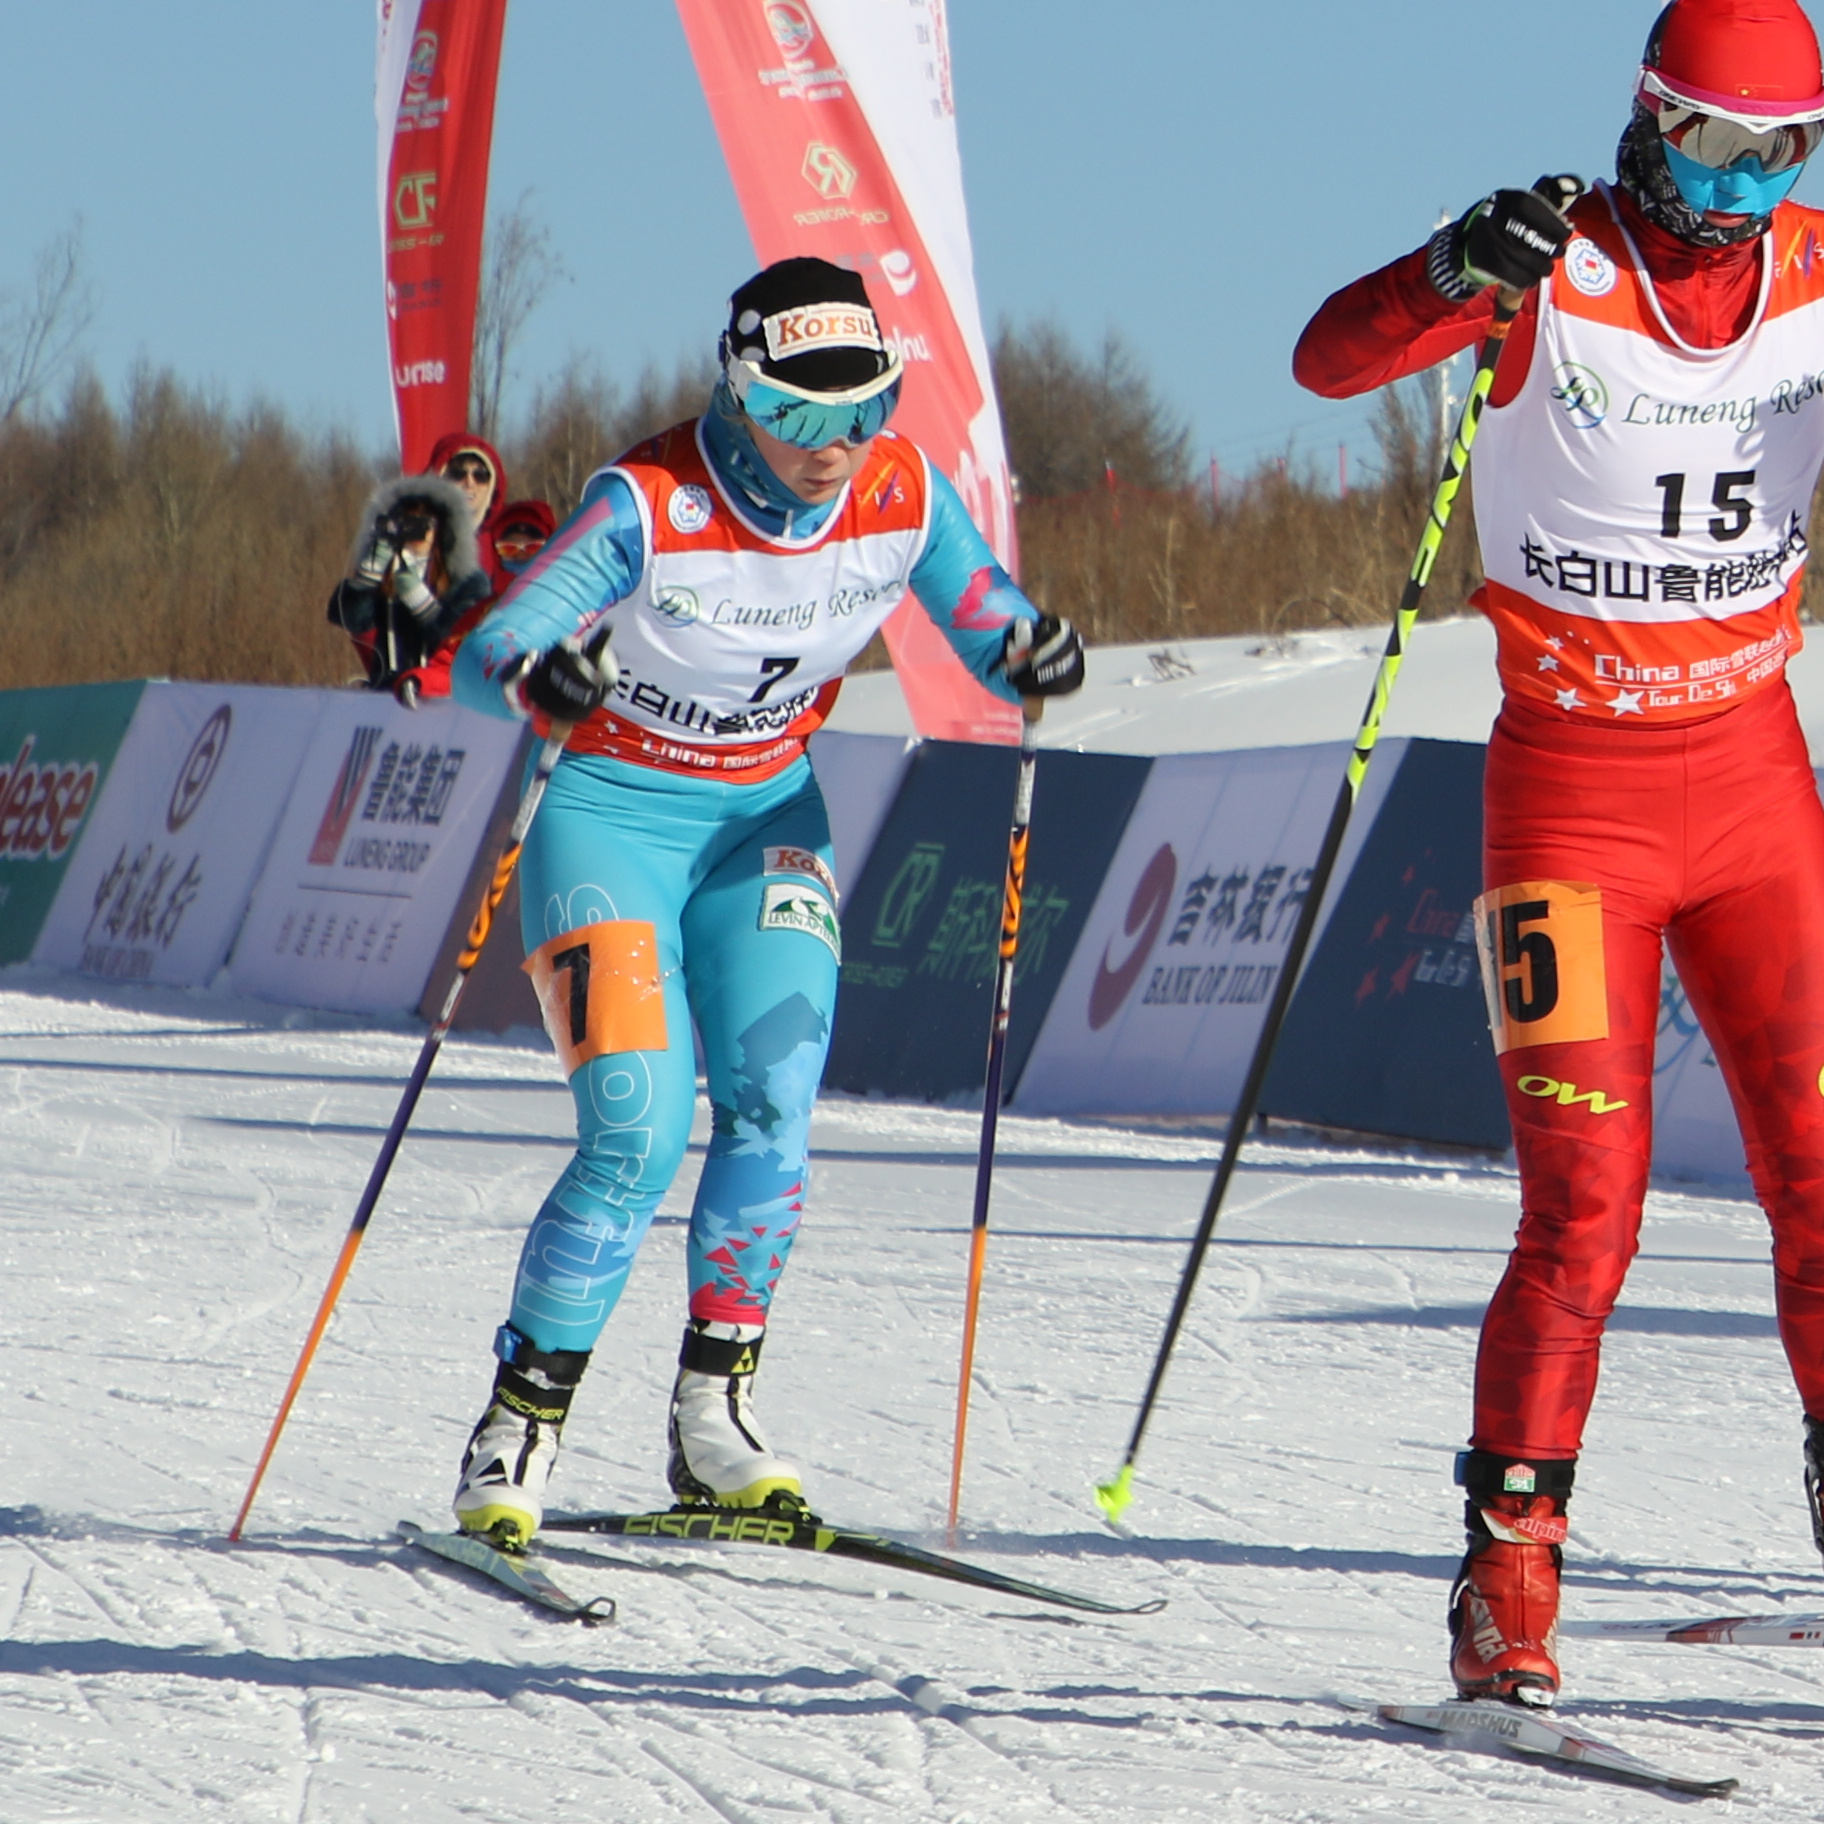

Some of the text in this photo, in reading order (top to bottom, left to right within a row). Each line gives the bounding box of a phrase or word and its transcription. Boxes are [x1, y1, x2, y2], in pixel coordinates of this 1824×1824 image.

[777, 312, 873, 347] Korsu
[1621, 393, 1758, 433] Luneng
[1656, 470, 1756, 542] 15
[710, 598, 818, 631] Luneng
[747, 656, 801, 704] 7
[1594, 654, 1681, 683] China
[1647, 690, 1683, 708] Tour
[1688, 684, 1714, 704] De
[362, 741, 466, 827] 鲁能集团
[344, 836, 431, 874] LUNENG GROUP
[767, 911, 804, 927] LEVIN
[1142, 967, 1278, 1006] BANK OF JILIN
[1516, 1074, 1630, 1115] OW
[495, 1386, 565, 1420] FISCHER
[622, 1513, 795, 1547] FISCHER
[1437, 1709, 1525, 1740] MADSHUS
